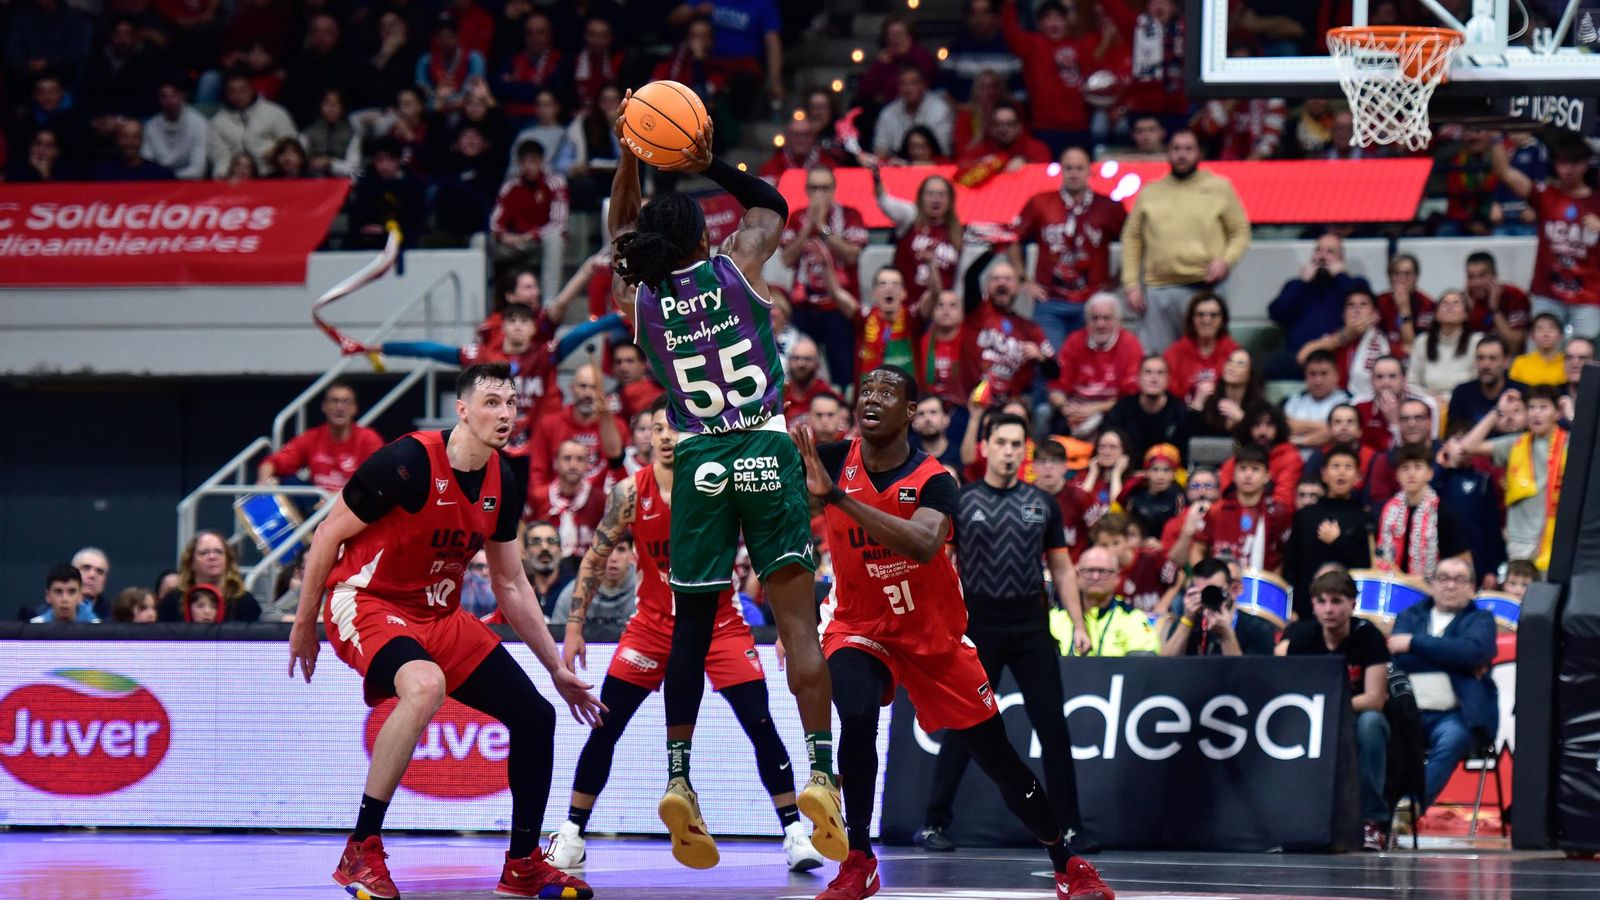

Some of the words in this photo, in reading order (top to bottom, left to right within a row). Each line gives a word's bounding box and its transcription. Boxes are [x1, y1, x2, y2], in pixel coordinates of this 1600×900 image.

[25, 201, 275, 231] Soluciones
[660, 287, 722, 320] Perry
[672, 338, 768, 418] 55
[733, 456, 779, 471] COSTA
[733, 471, 759, 482] DEL
[761, 469, 780, 480] SOL
[734, 480, 782, 492] MÁLAGA
[882, 579, 916, 615] 21
[0, 707, 161, 758] Juver
[411, 721, 511, 762] uve
